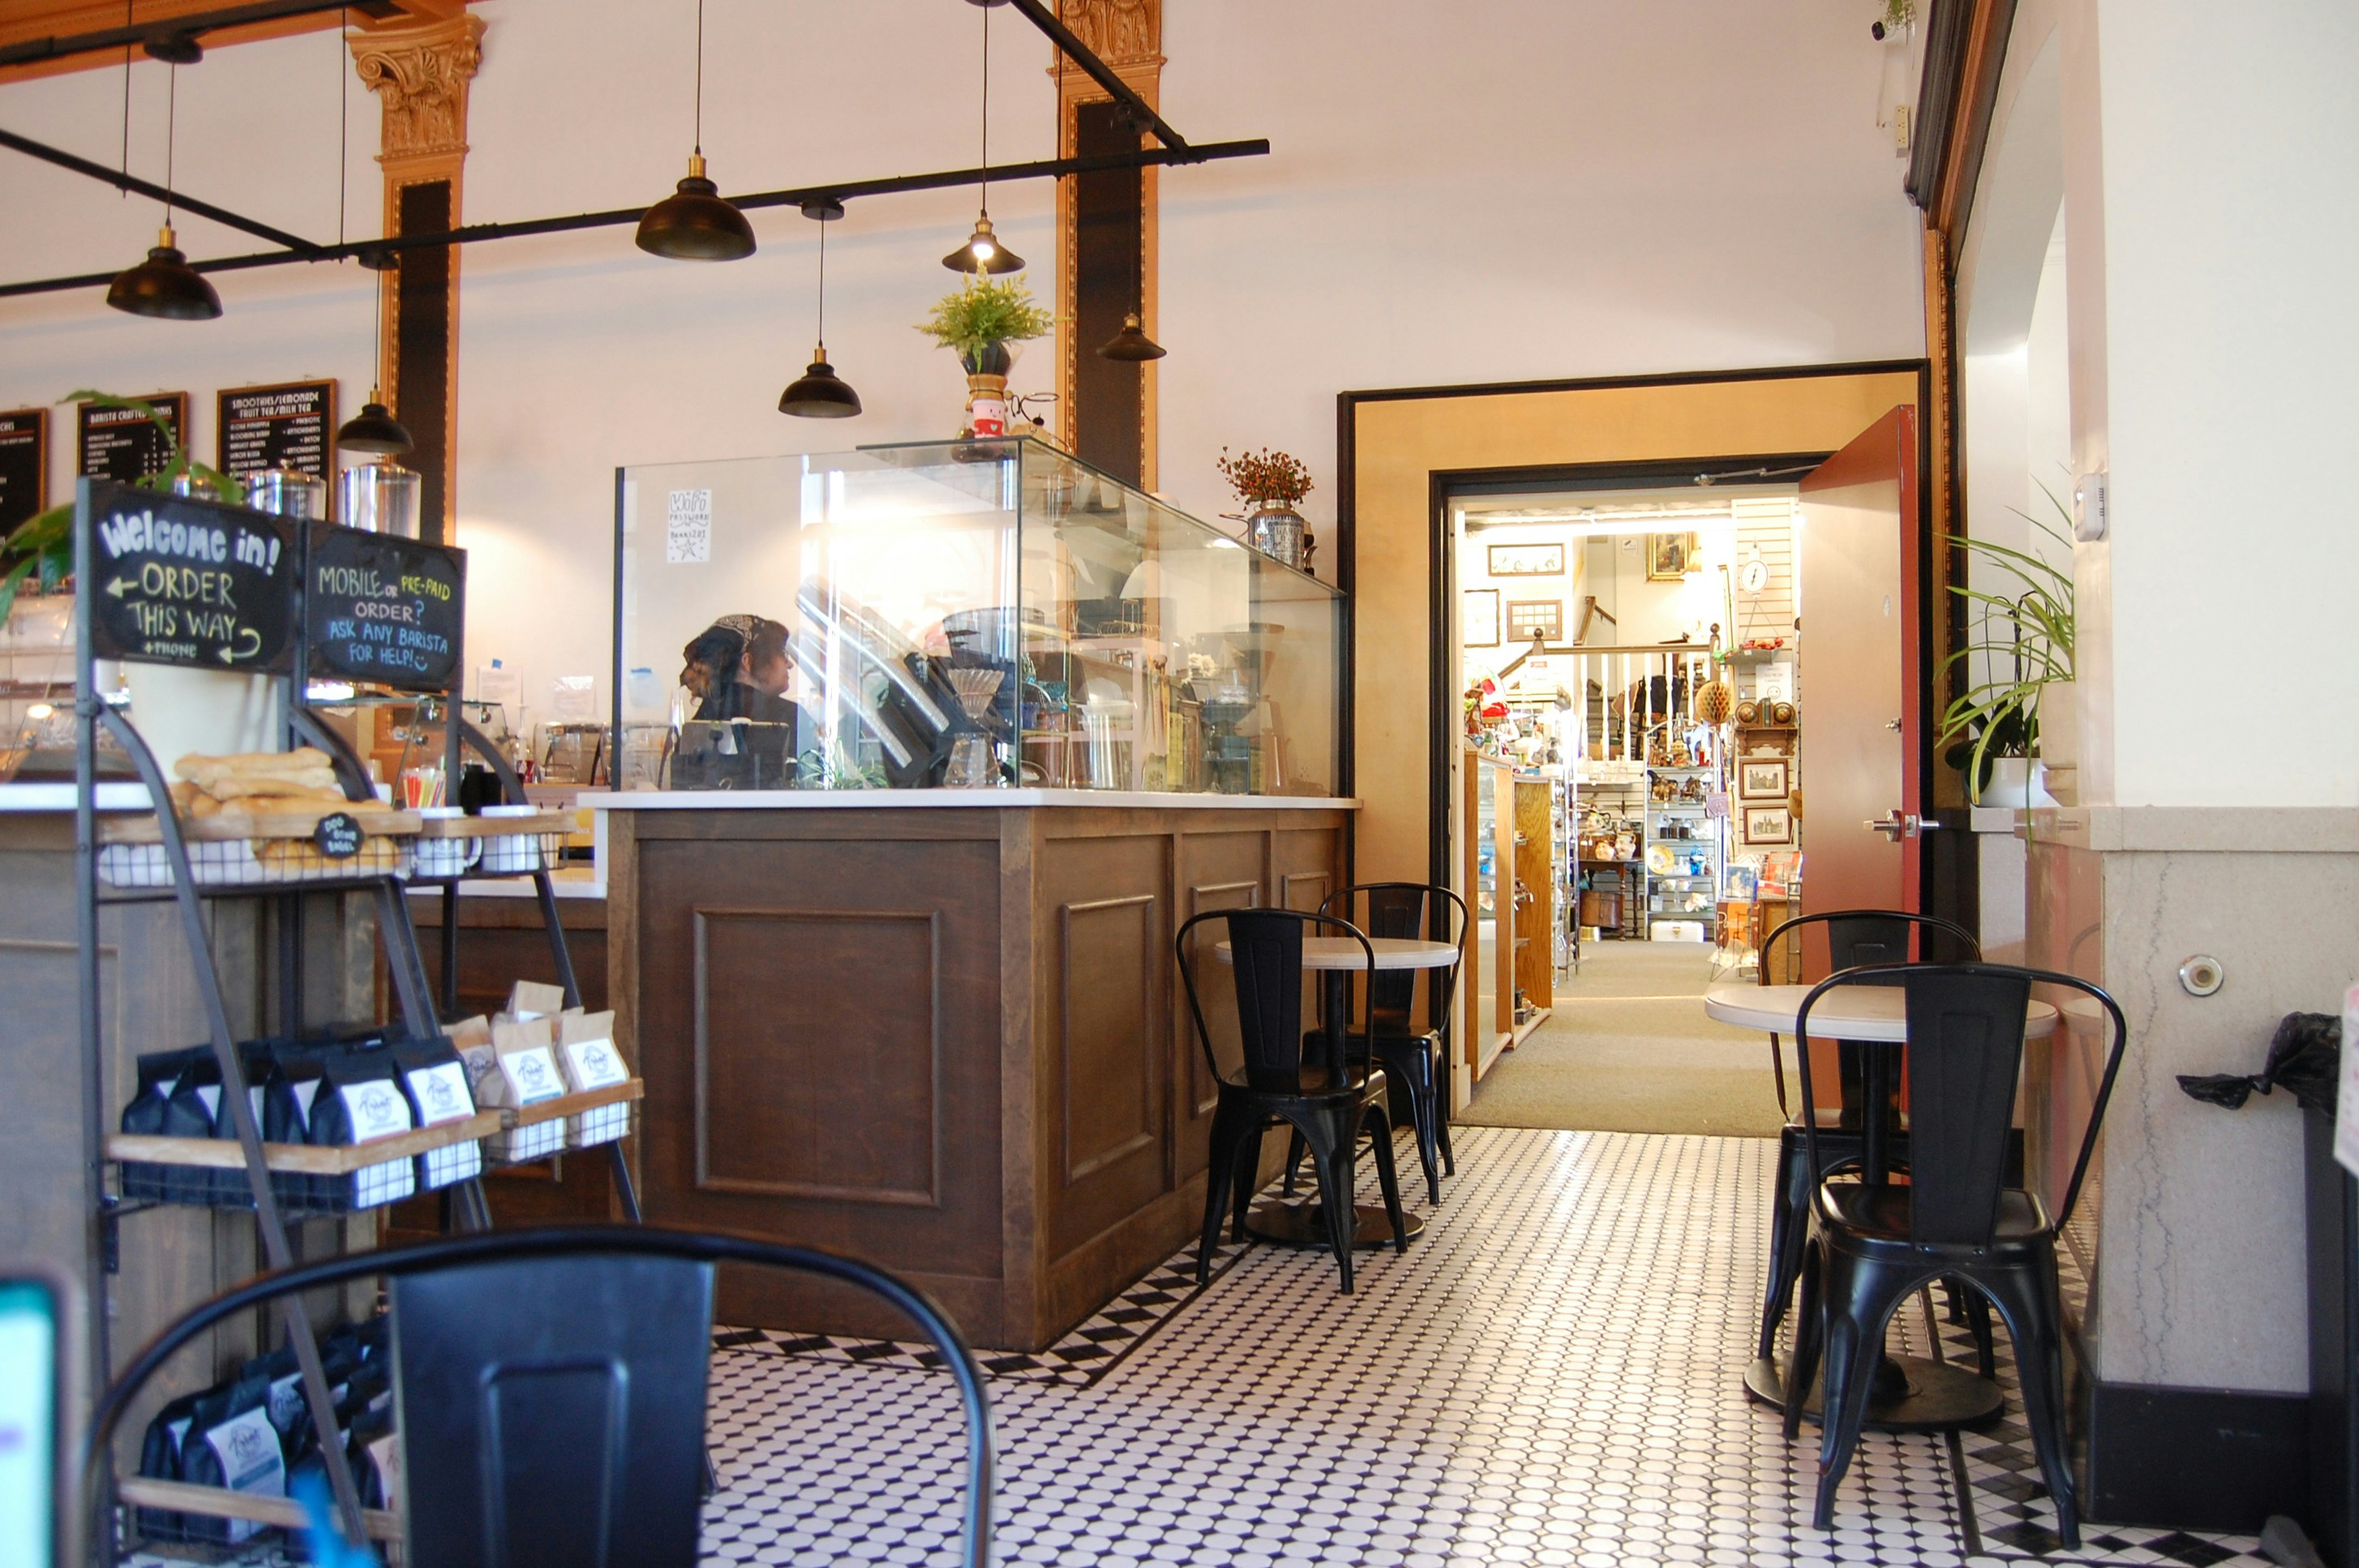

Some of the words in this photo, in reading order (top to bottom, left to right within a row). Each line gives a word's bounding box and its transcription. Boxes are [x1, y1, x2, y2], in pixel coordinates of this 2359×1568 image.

[232, 392, 319, 409] SMOOTHIES/LEMONADE
[239, 407, 259, 419] FRUIT
[298, 403, 311, 413] TEA
[101, 510, 227, 563] Welcome
[236, 528, 281, 576] in!
[143, 562, 237, 610] ORDER
[319, 567, 384, 598] MOBILE
[401, 576, 451, 601] PRE-PAID
[187, 610, 236, 641] WAY
[355, 600, 425, 625] ORDER?
[330, 619, 357, 640] ASK
[363, 622, 393, 645] ANY
[350, 643, 373, 662] FOR
[380, 648, 414, 668] HELP!
